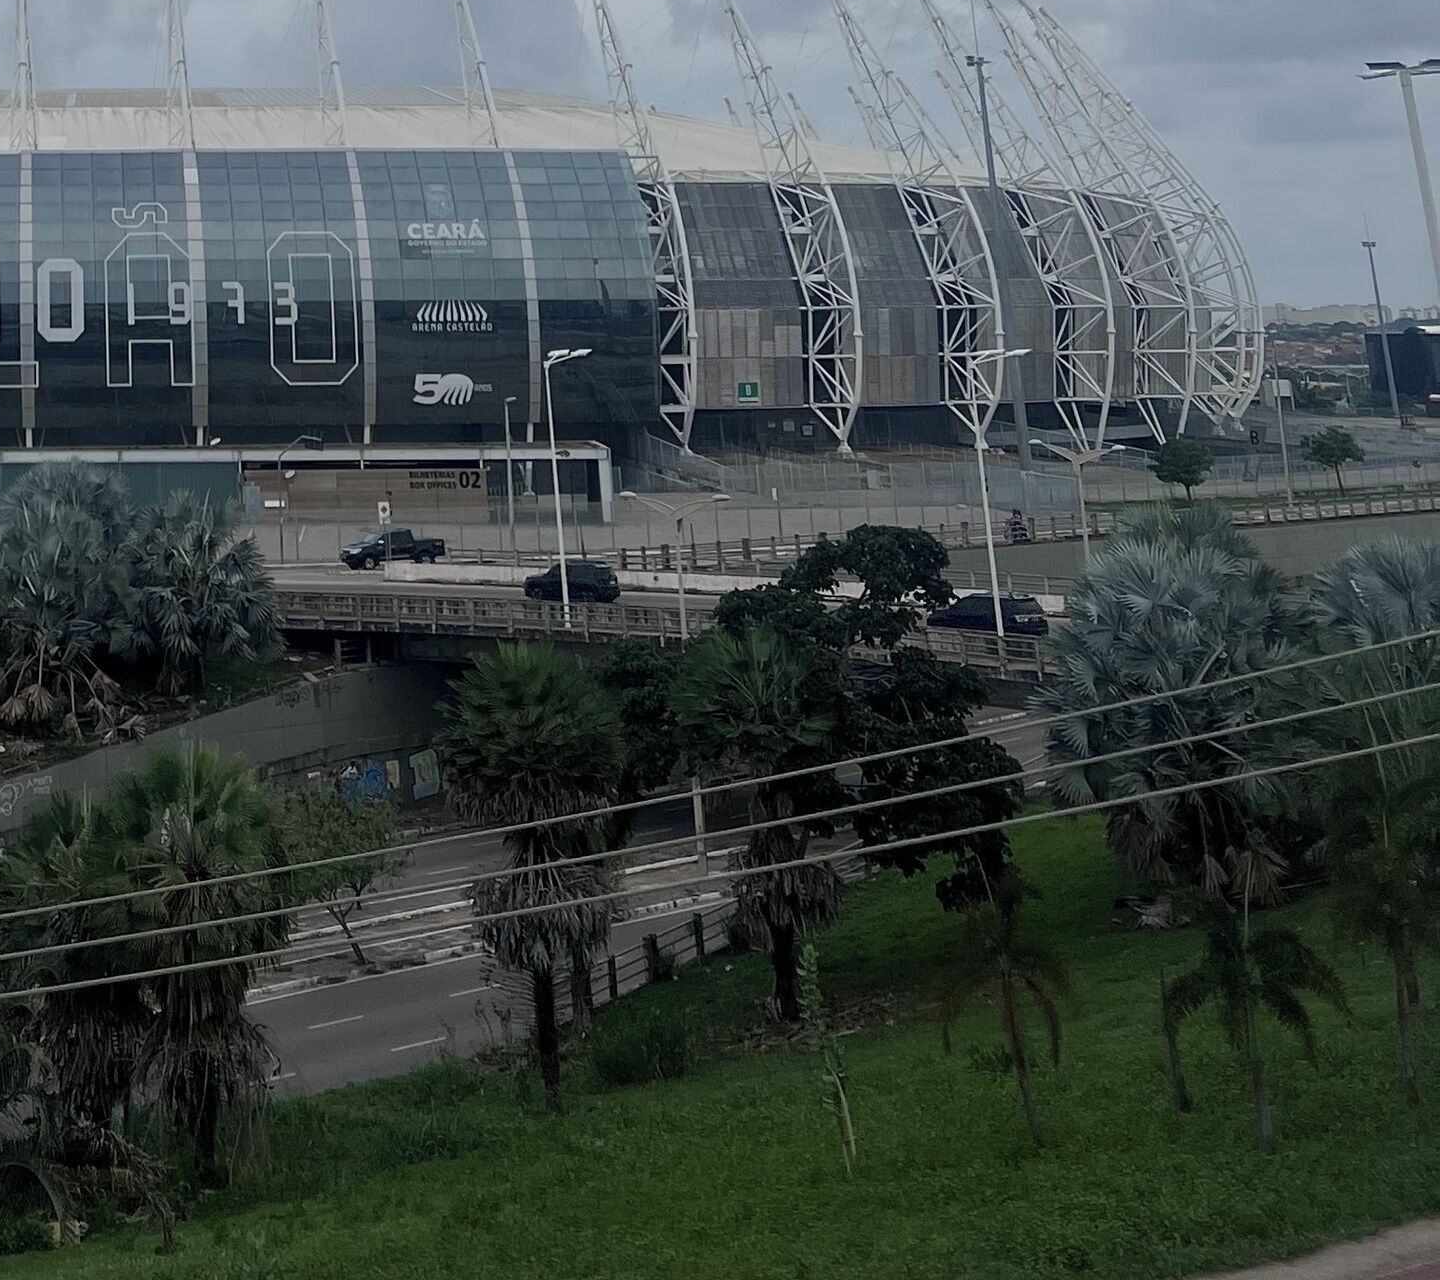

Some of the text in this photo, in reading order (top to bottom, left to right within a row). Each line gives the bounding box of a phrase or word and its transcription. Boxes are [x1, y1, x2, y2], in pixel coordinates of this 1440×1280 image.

[407, 218, 485, 239] CEARÁ
[458, 239, 488, 247] ESTADO
[126, 281, 299, 326] 1973
[412, 321, 493, 331] ARENA CASTELÃO
[1250, 430, 1259, 445] B
[459, 471, 481, 489] 02
